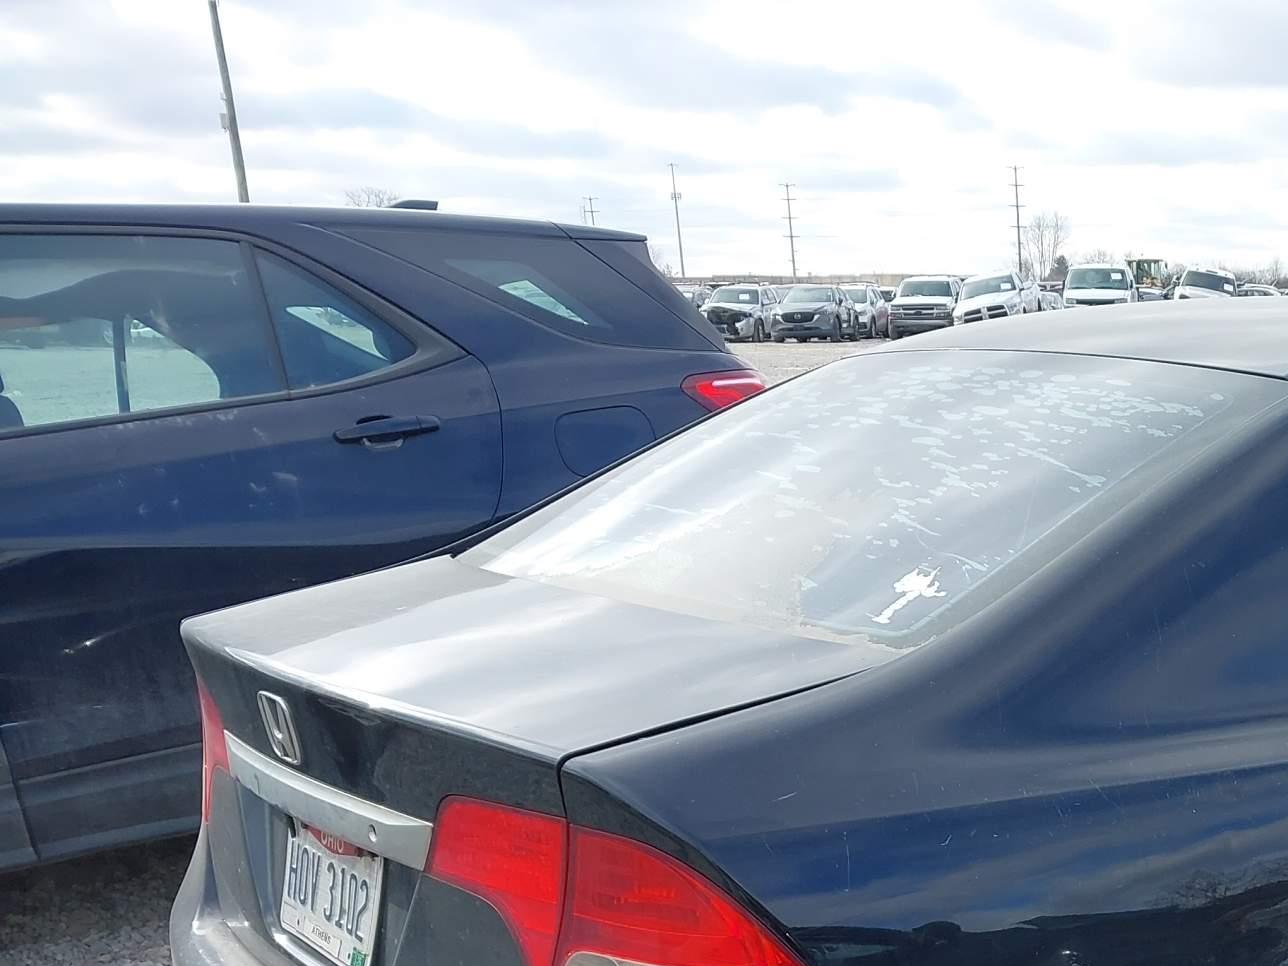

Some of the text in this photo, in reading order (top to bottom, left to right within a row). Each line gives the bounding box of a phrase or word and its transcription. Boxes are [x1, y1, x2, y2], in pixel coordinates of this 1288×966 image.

[320, 831, 345, 854] OHIO
[287, 841, 370, 943] HOV 3102
[311, 925, 332, 945] ATHENS
